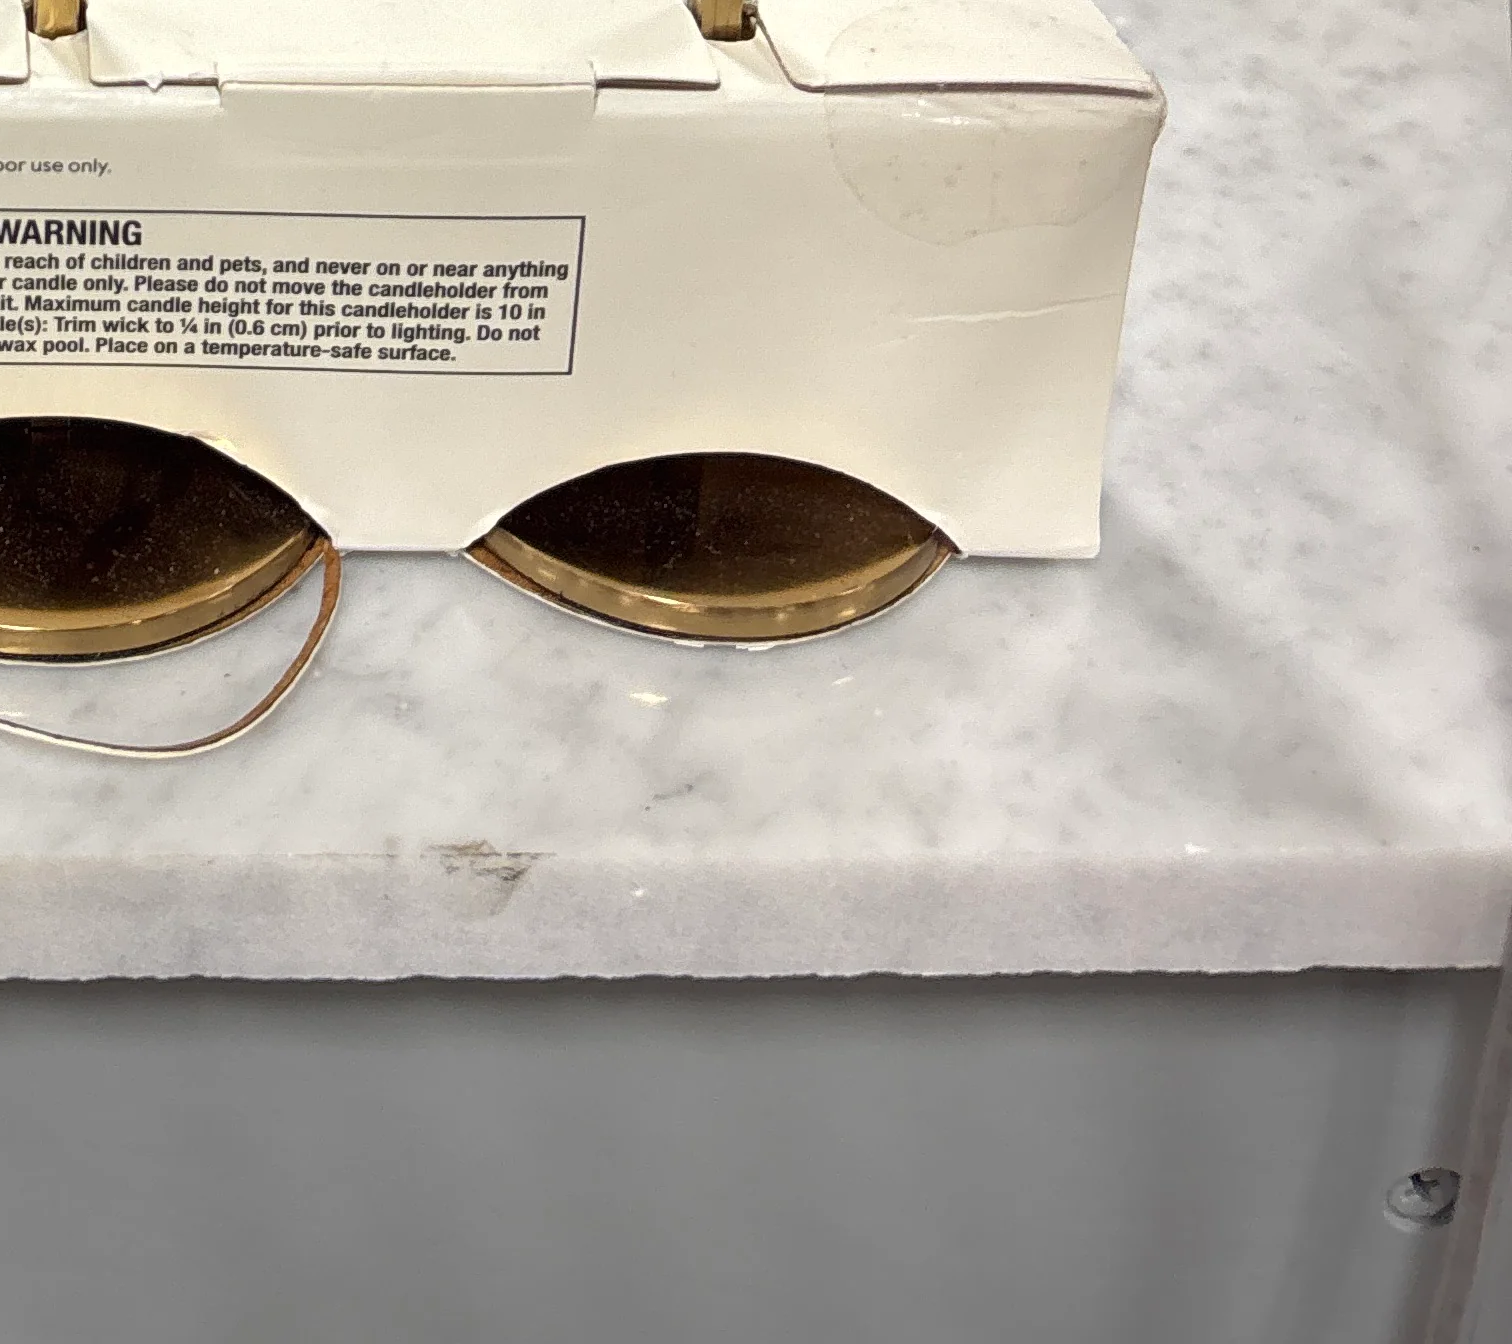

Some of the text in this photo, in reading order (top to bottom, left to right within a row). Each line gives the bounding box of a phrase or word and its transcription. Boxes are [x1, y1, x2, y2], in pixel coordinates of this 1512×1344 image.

[31, 161, 63, 172] use
[68, 158, 111, 177] only.
[4, 253, 60, 270] reach
[66, 253, 85, 270] of
[90, 253, 171, 271] children
[176, 255, 214, 271] and
[219, 256, 267, 276] pets,
[273, 257, 309, 273] and
[315, 261, 371, 275] never
[374, 263, 400, 276] on
[406, 263, 428, 276] or
[432, 264, 478, 277] near
[482, 260, 569, 281] anything
[12, 274, 78, 291] candle
[83, 275, 128, 295] only.
[134, 275, 200, 292] Please
[204, 276, 229, 293] do
[234, 278, 267, 294] not
[272, 281, 326, 296] move
[331, 280, 363, 296] the
[368, 281, 498, 299] candleholder
[502, 280, 548, 299] from
[24, 293, 121, 312] Maximum
[126, 296, 194, 313] candle
[198, 297, 260, 319] height
[265, 299, 294, 315] for
[298, 300, 336, 317] this
[341, 302, 471, 320] candleholder
[475, 303, 492, 320] is
[498, 304, 522, 320] 10
[527, 303, 545, 320] in
[53, 316, 96, 332] Trim
[102, 316, 150, 333] wick
[154, 318, 174, 333] to
[204, 318, 222, 334] in
[228, 319, 265, 338] (0.6
[270, 320, 307, 340] cm)
[313, 321, 362, 340] prior
[365, 323, 385, 339] to
[391, 323, 471, 345] lighting.
[476, 325, 503, 341] Do
[508, 325, 541, 341] not
[43, 337, 90, 355] pool.
[95, 337, 148, 353] Place
[154, 341, 178, 354] on
[184, 342, 195, 354] a
[200, 337, 374, 359] temperature-safe
[377, 341, 458, 361] surface.
